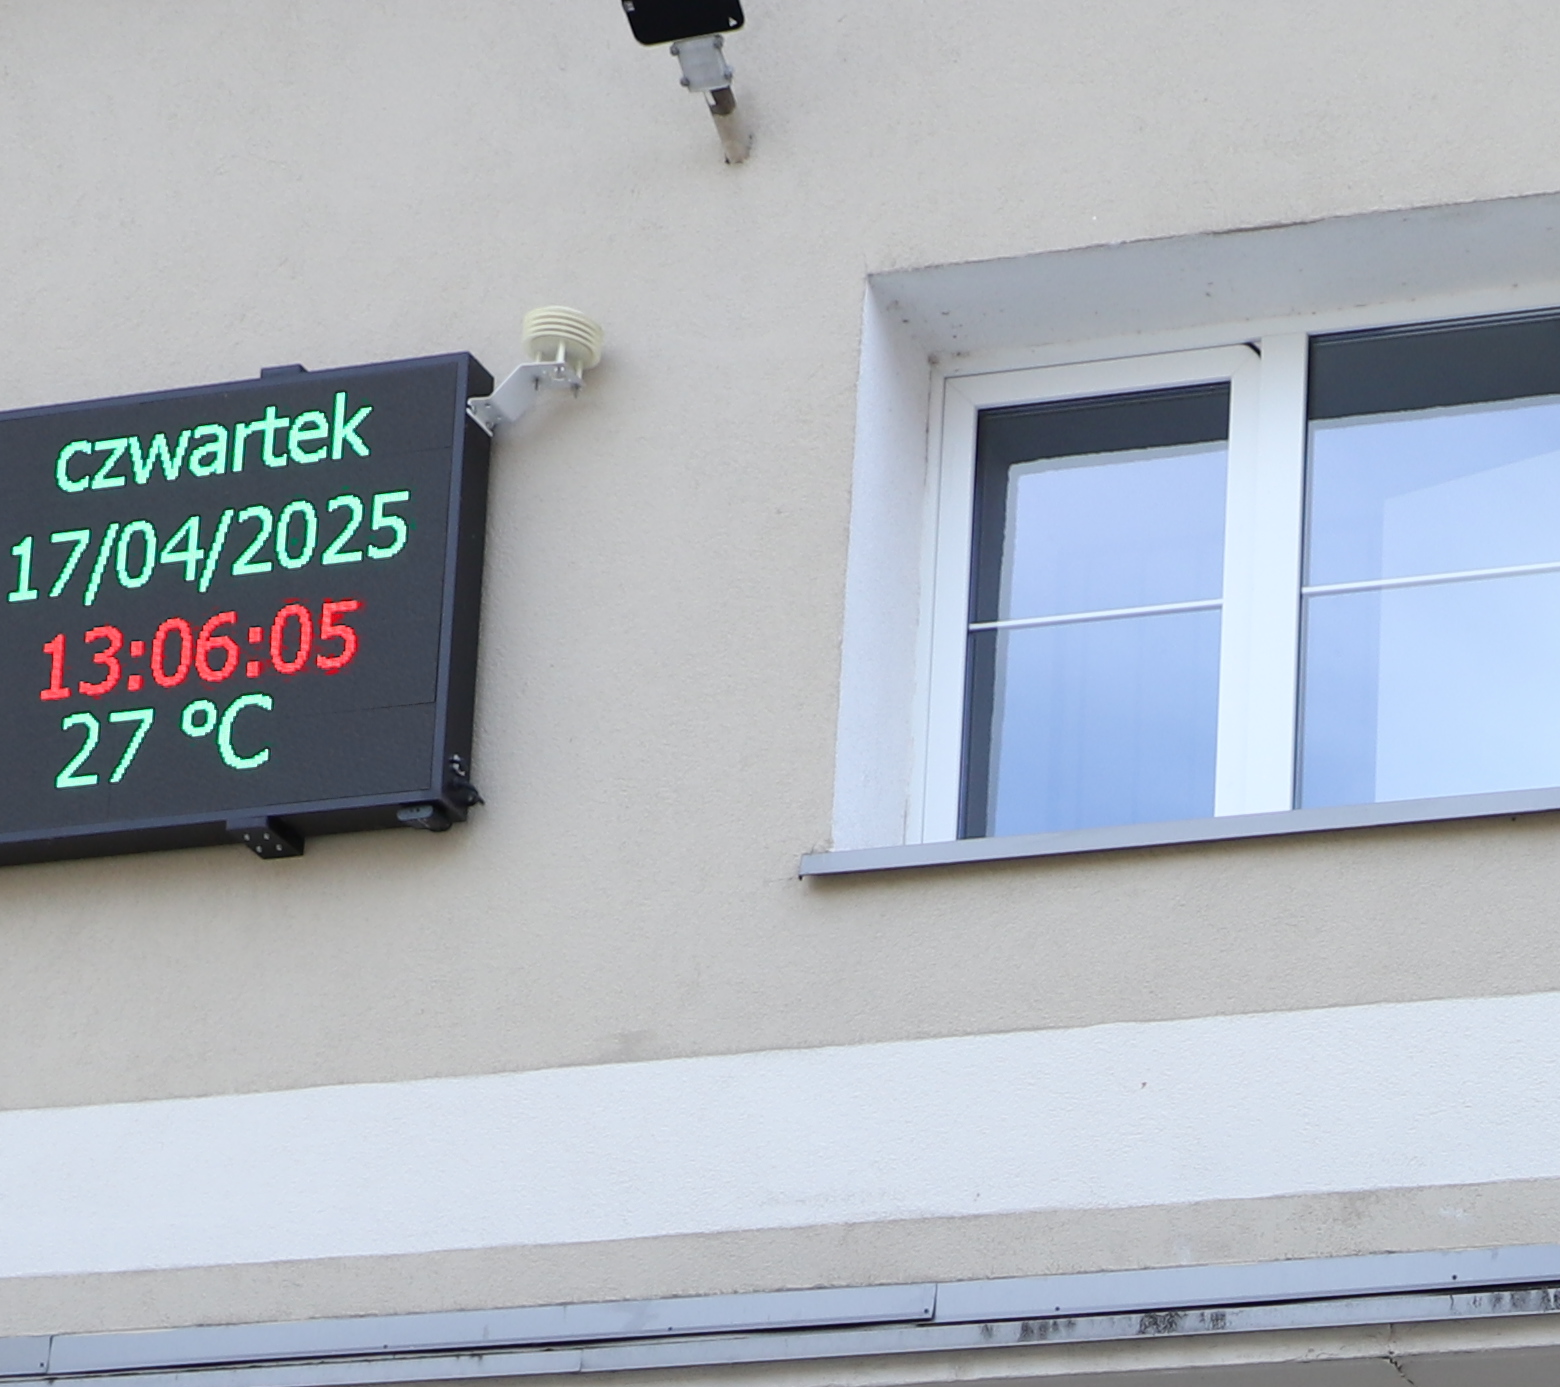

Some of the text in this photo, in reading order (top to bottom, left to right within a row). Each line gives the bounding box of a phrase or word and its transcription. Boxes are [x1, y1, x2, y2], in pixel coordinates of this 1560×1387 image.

[57, 392, 372, 492] czwartek
[9, 491, 409, 605] 17/04/2025
[41, 599, 361, 700] 13:06:05
[56, 709, 153, 788] 27
